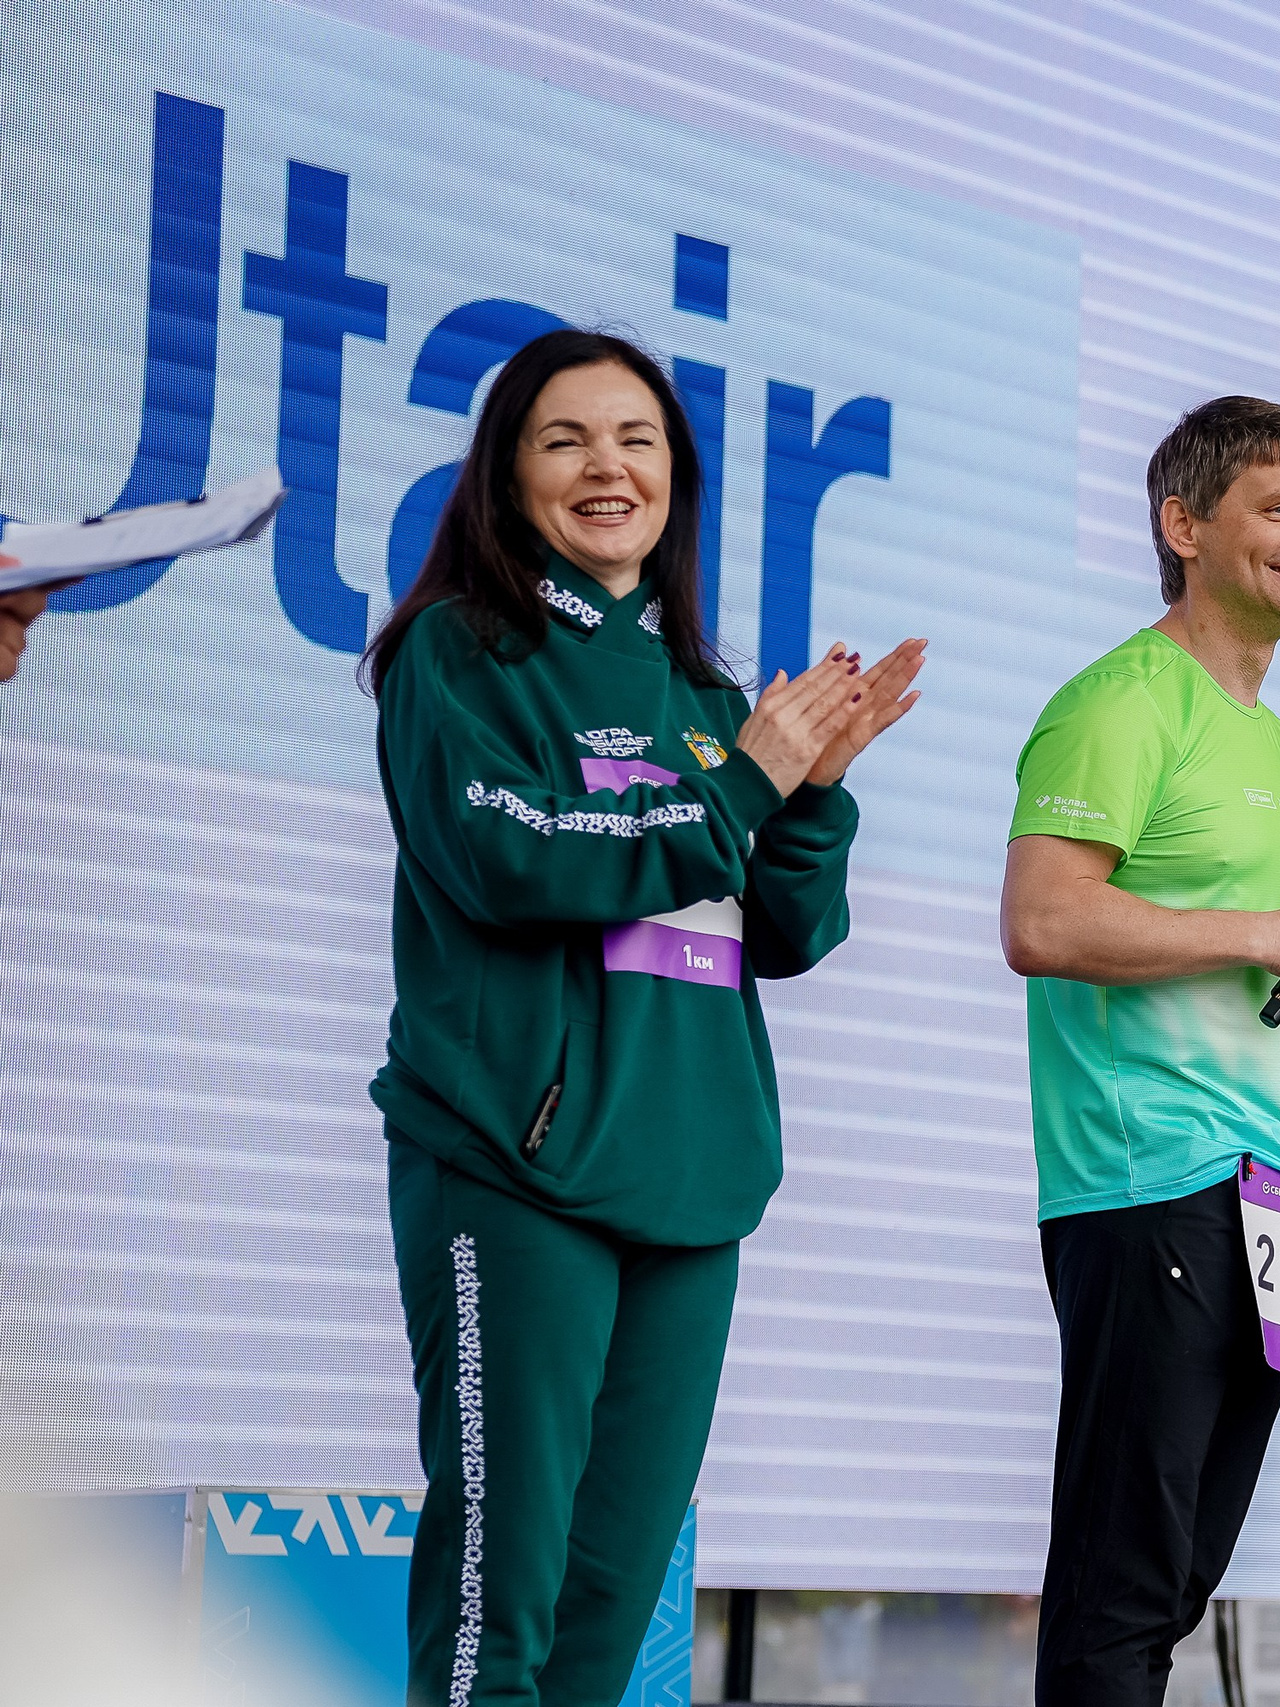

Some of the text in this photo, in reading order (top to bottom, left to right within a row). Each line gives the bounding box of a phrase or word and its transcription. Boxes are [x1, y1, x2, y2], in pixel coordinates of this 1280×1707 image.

[585, 727, 633, 739] ЮГРА
[593, 746, 644, 757] СПОРТ
[1053, 795, 1088, 808] Вклад
[1060, 805, 1107, 820] будущее
